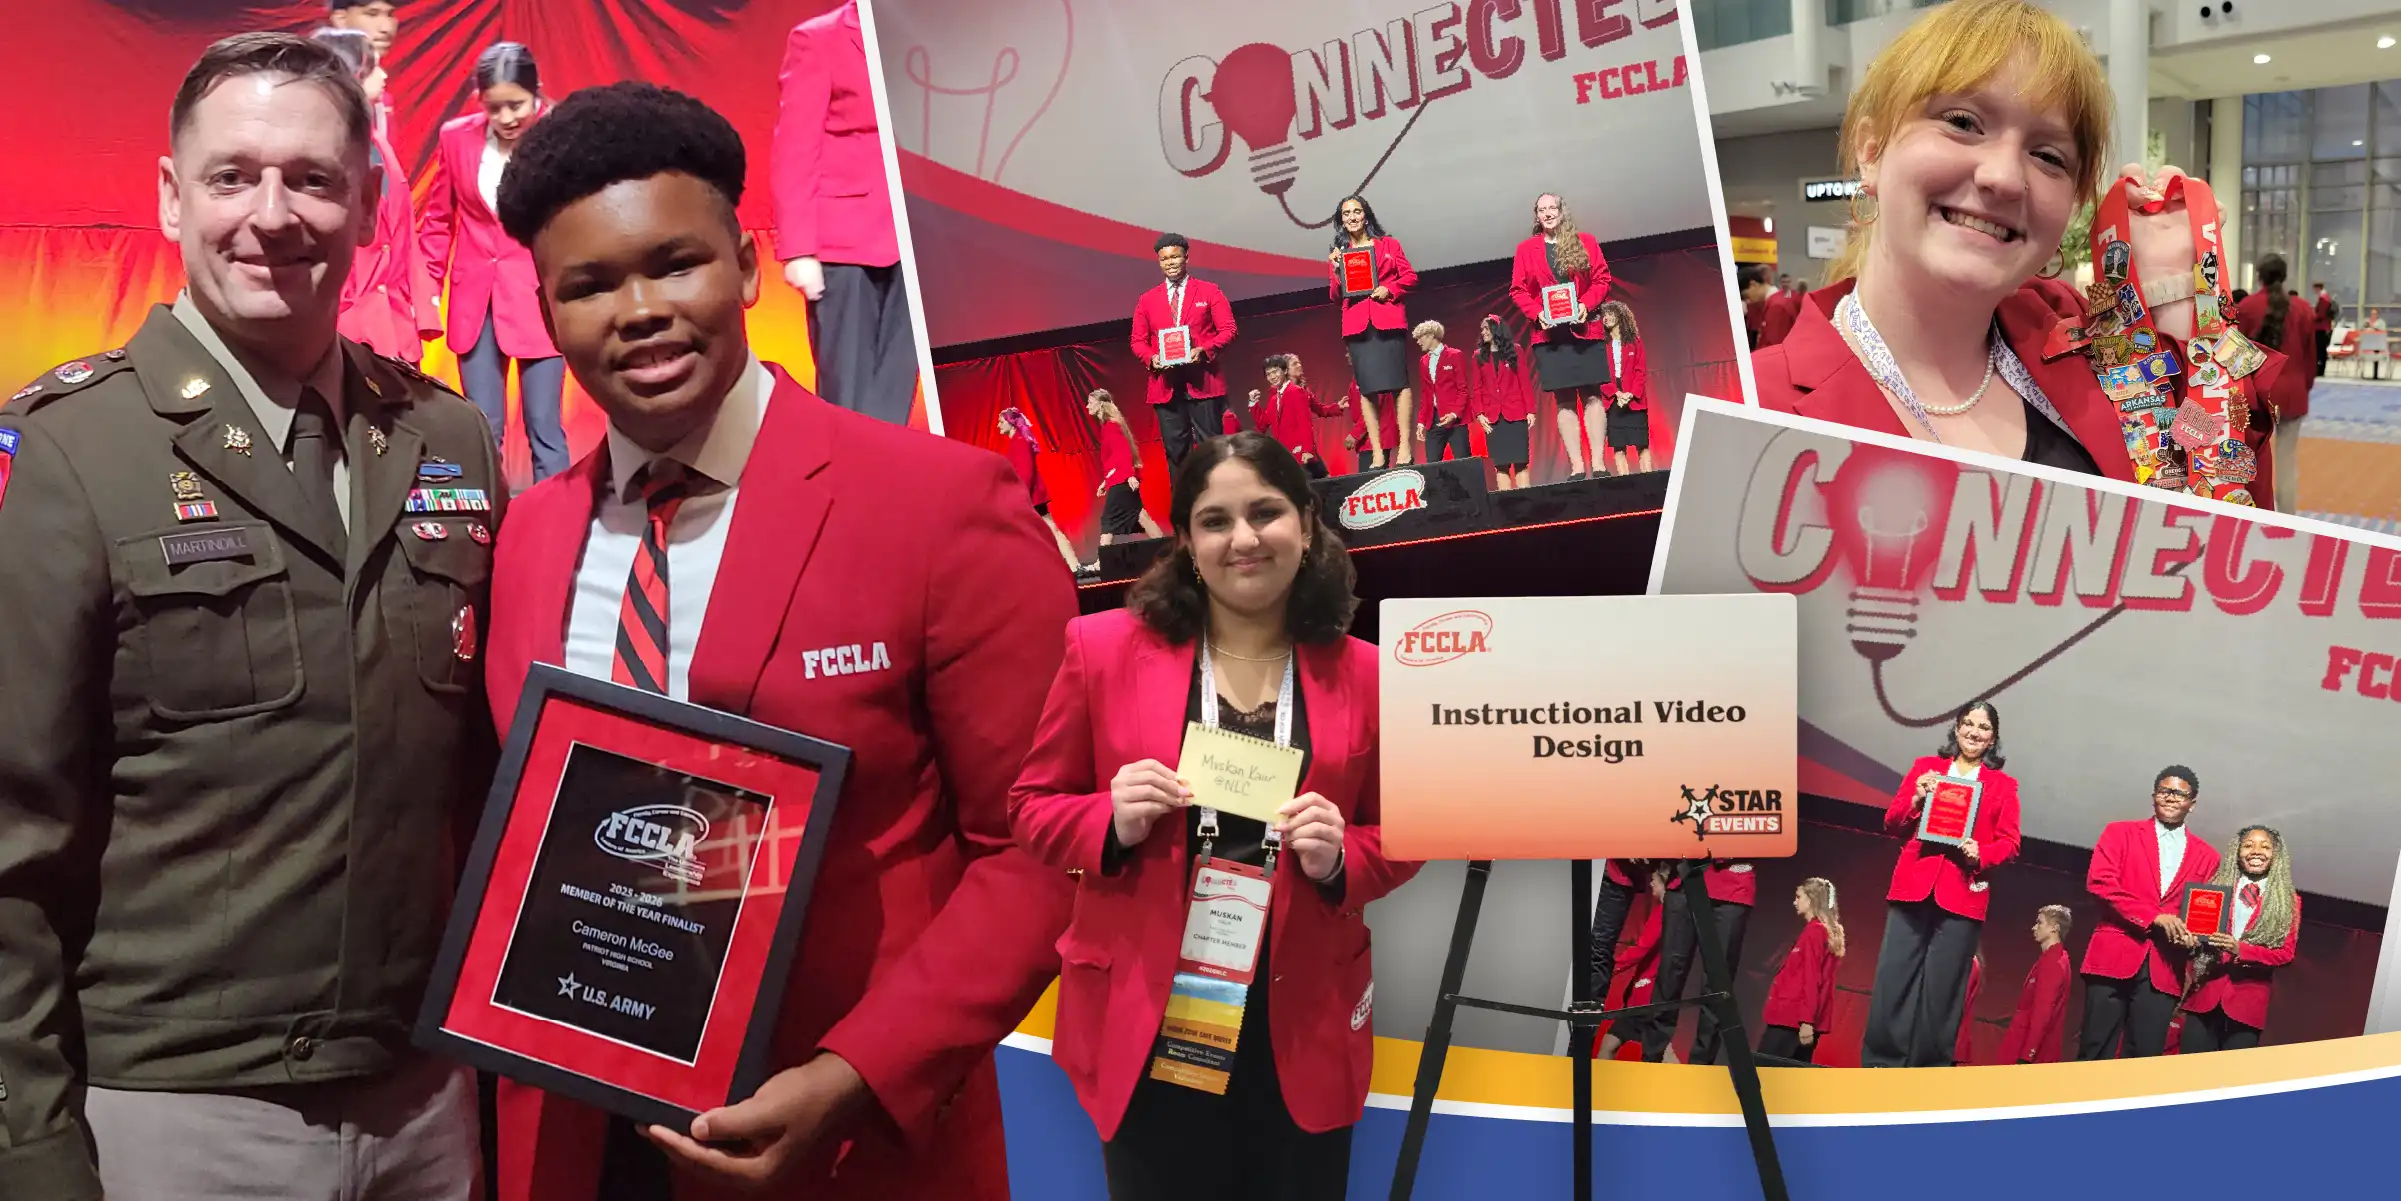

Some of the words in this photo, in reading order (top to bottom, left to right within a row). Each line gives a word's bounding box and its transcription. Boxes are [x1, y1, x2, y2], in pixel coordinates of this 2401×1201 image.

[2087, 295, 2117, 317] INDIANA
[2120, 395, 2166, 412] ARKANSAS
[2180, 423, 2204, 442] FCCLA
[1347, 488, 1421, 517] FCCLA
[170, 537, 248, 556] MARTINDILL
[1404, 630, 1486, 653] FCCLA
[802, 641, 892, 680] FCCLA
[1431, 700, 1643, 726] Instructional
[1653, 700, 1747, 723] Video
[1532, 734, 1644, 764] Design
[1719, 789, 1782, 812] STAR
[606, 811, 696, 861] FCCLA
[1709, 817, 1779, 832] EVENTS
[609, 883, 634, 898] 2025
[639, 892, 664, 908] 2026
[560, 883, 602, 906] MEMBER
[602, 896, 617, 909] OF
[617, 900, 636, 915] THE
[636, 906, 661, 923] YEAR
[661, 914, 706, 935] FINALIST
[1209, 909, 1244, 923] MUSKAN
[572, 920, 628, 948] Cameron
[629, 935, 674, 961] McGee
[582, 942, 610, 957] PATRIOT
[609, 950, 626, 962] HIGH
[626, 956, 654, 970] SCHOOL
[582, 985, 608, 1007] U.S.
[609, 994, 657, 1020] ARMY
